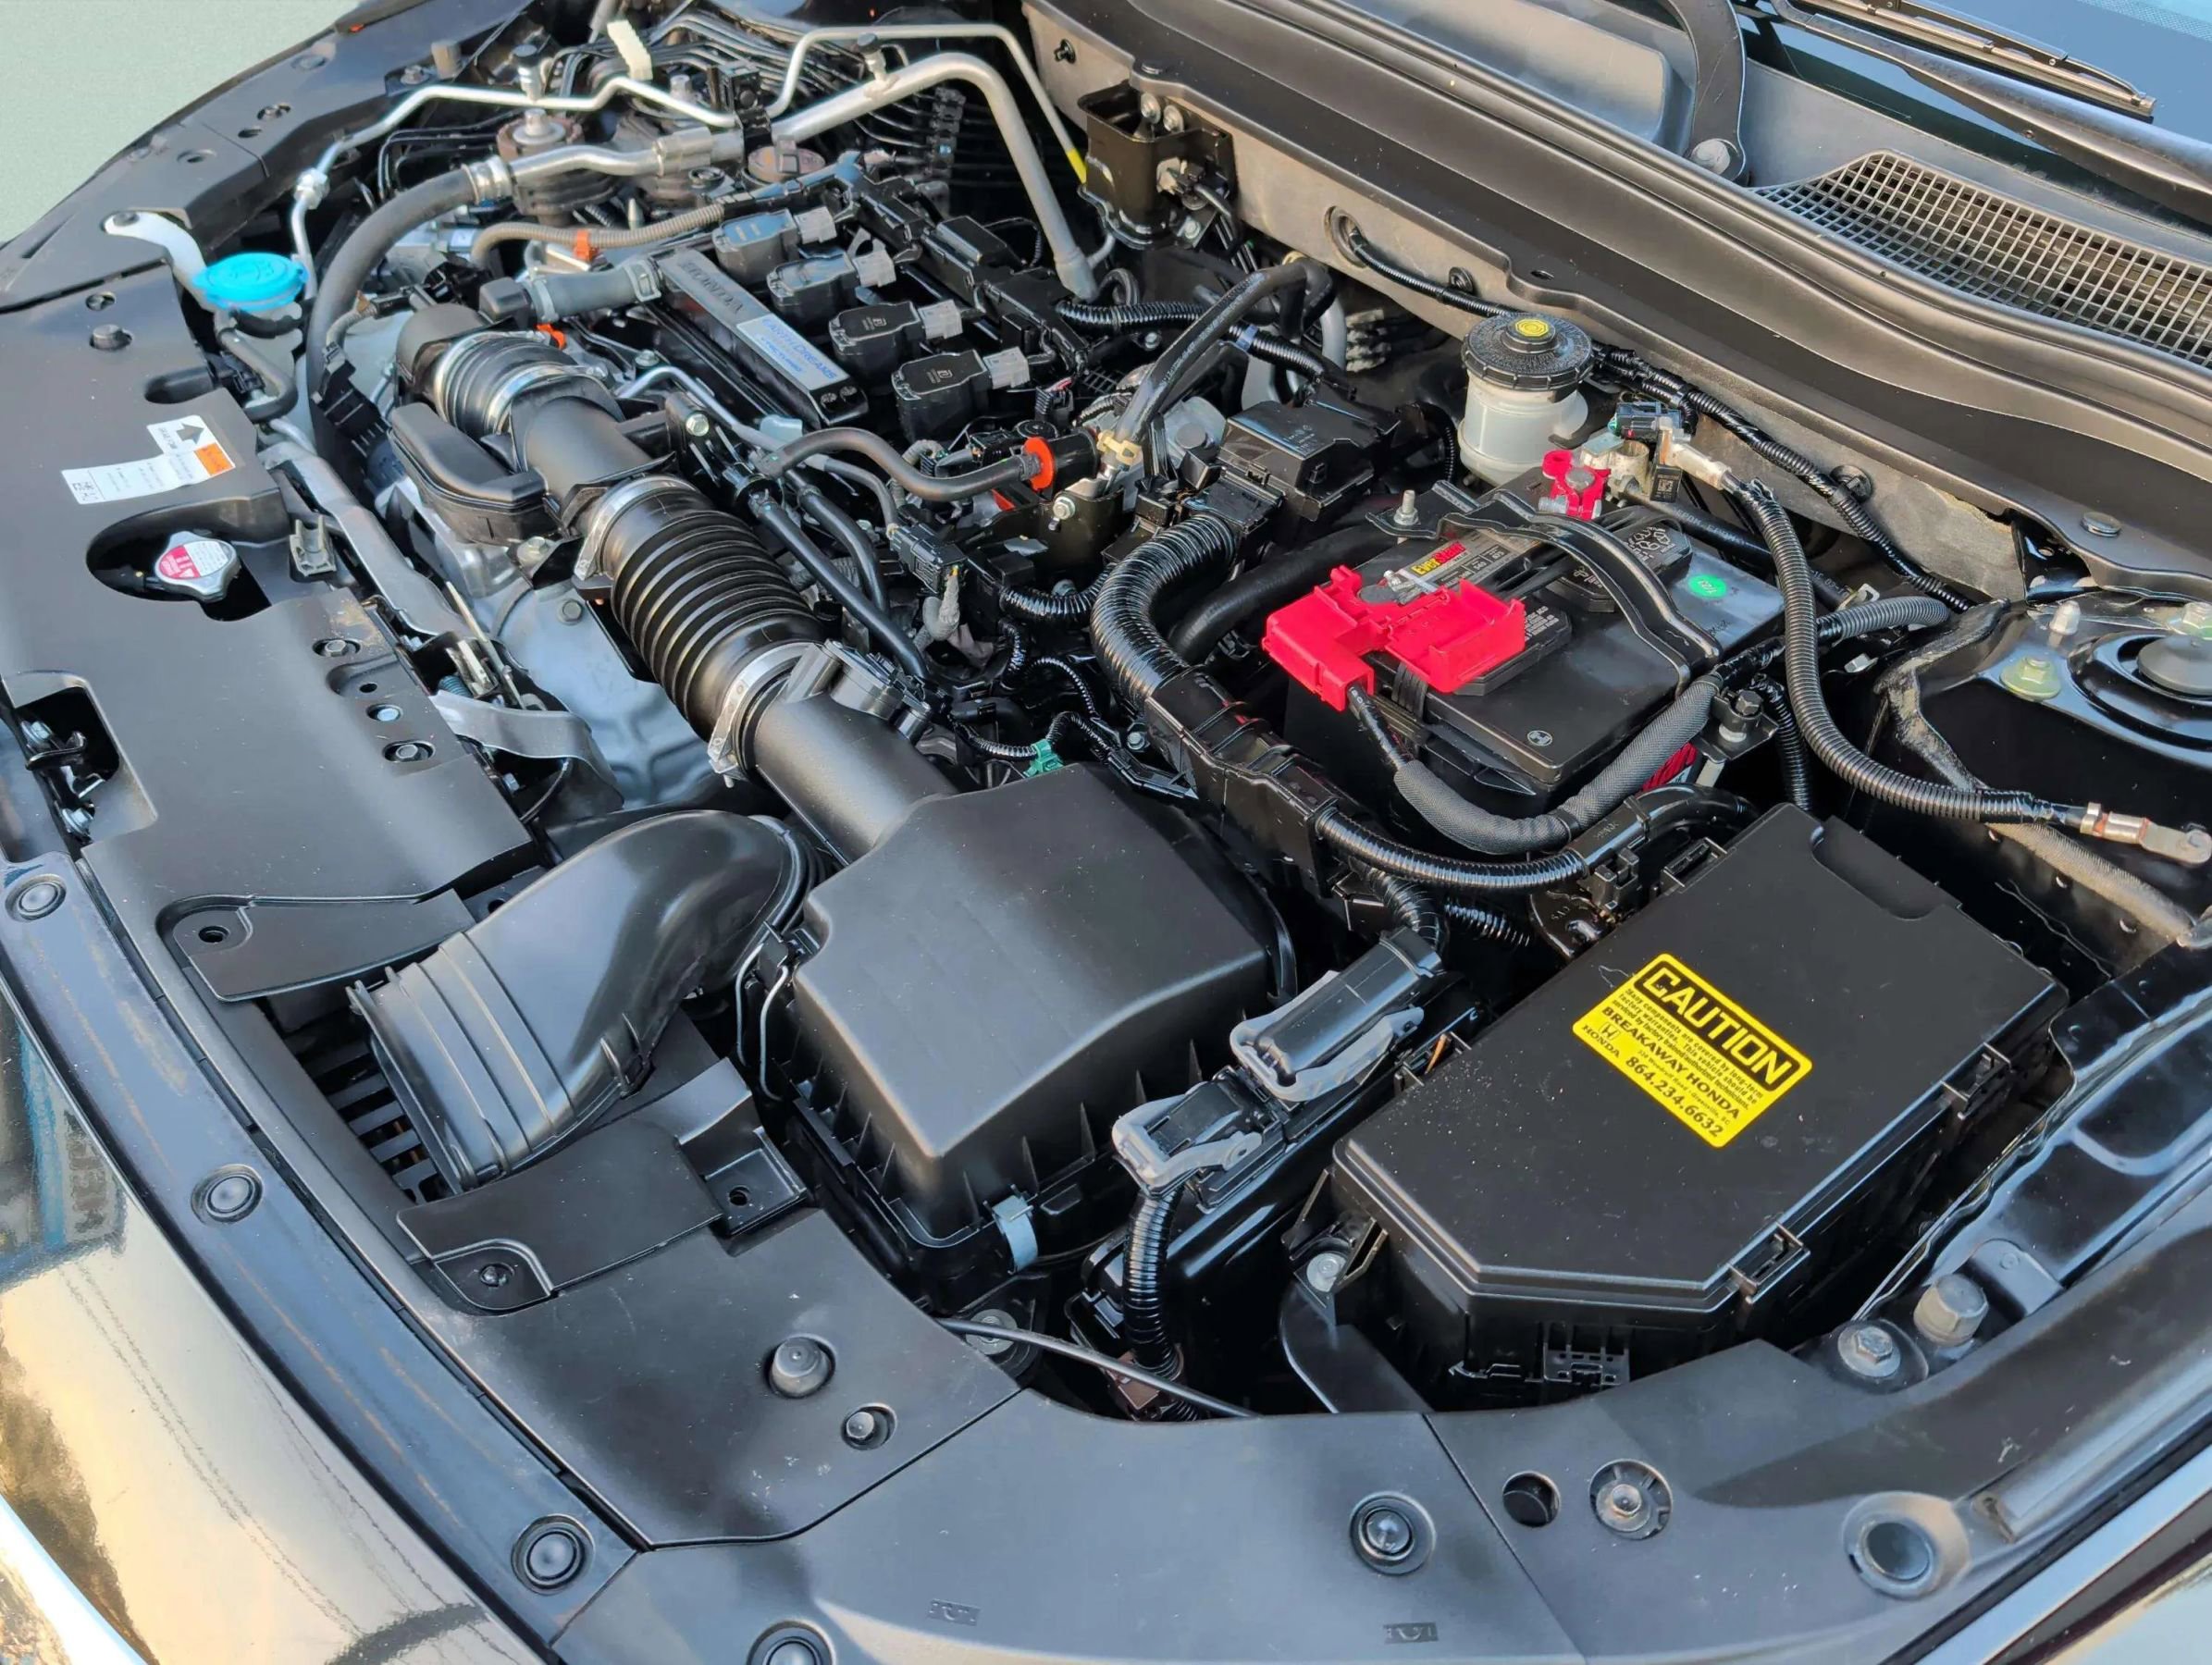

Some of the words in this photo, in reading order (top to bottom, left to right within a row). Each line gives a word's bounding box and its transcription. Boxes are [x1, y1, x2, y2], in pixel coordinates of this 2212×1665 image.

[1410, 541, 1467, 575] EverStart
[1579, 1023, 1623, 1058] HONDA
[1600, 1005, 1688, 1076] BREAKAWAY
[1684, 1071, 1743, 1119] HONDA
[1610, 997, 1637, 1019] serviced
[1633, 1016, 1646, 1026] by
[1640, 1021, 1666, 1042] factory
[1616, 993, 1644, 1014] factory
[1681, 1042, 1699, 1058] This
[1696, 1054, 1724, 1078] vehicle
[1721, 1074, 1749, 1097] should
[1745, 1093, 1759, 1105] be
[1623, 987, 1645, 1005] Many
[1641, 1001, 1684, 1035] components
[1679, 1031, 1696, 1044] are
[1691, 1041, 1722, 1066] covered
[1718, 1062, 1731, 1072] by
[1727, 1068, 1765, 1099] long-term
[1640, 965, 1794, 1086] CAUTION
[1623, 1054, 1725, 1138] 864.234.6632
